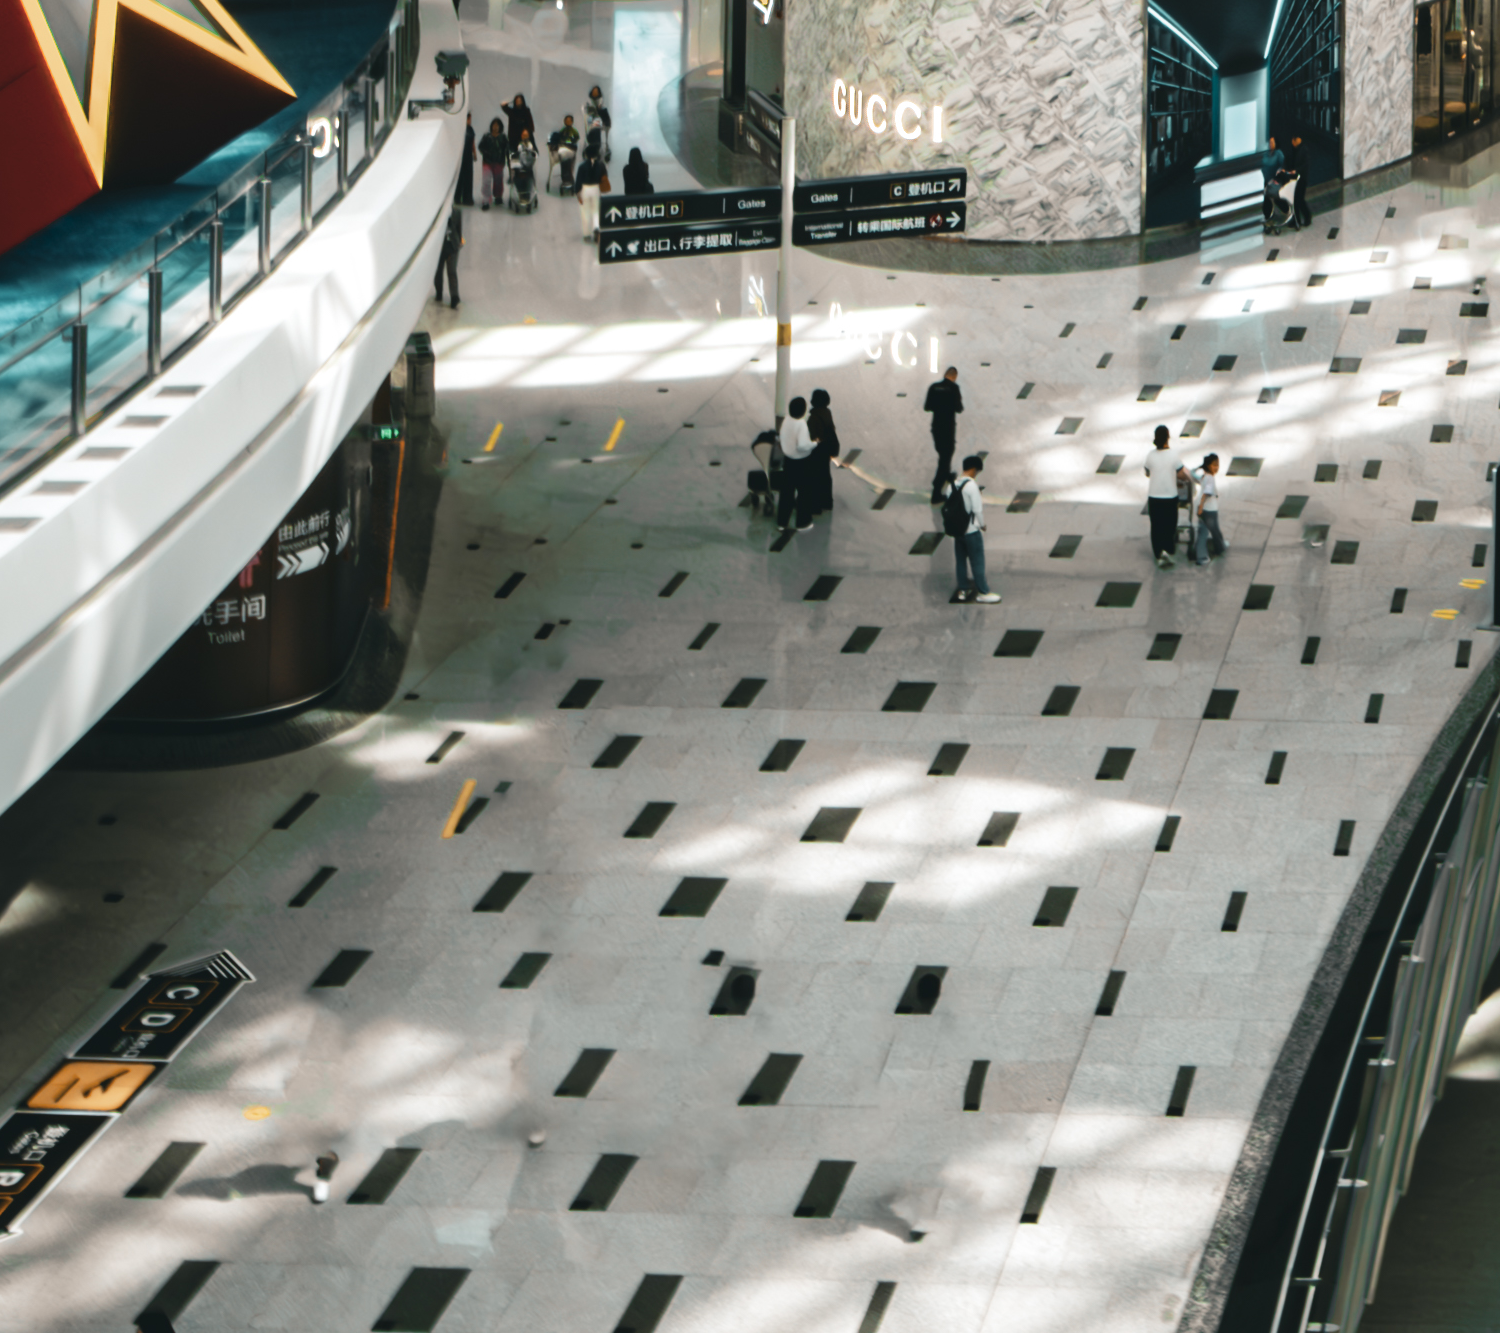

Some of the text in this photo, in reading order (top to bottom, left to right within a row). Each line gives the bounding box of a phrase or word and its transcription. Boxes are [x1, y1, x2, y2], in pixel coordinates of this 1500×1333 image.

[832, 77, 944, 144] GUCCI
[810, 181, 946, 204] Gates C 登机口
[625, 199, 767, 220] 登机口 D Gates
[643, 233, 733, 254] 出口、行李提取
[278, 510, 331, 543] 由此前行
[207, 629, 246, 645] Toilet
[166, 986, 200, 1000] C
[141, 1013, 176, 1027] D
